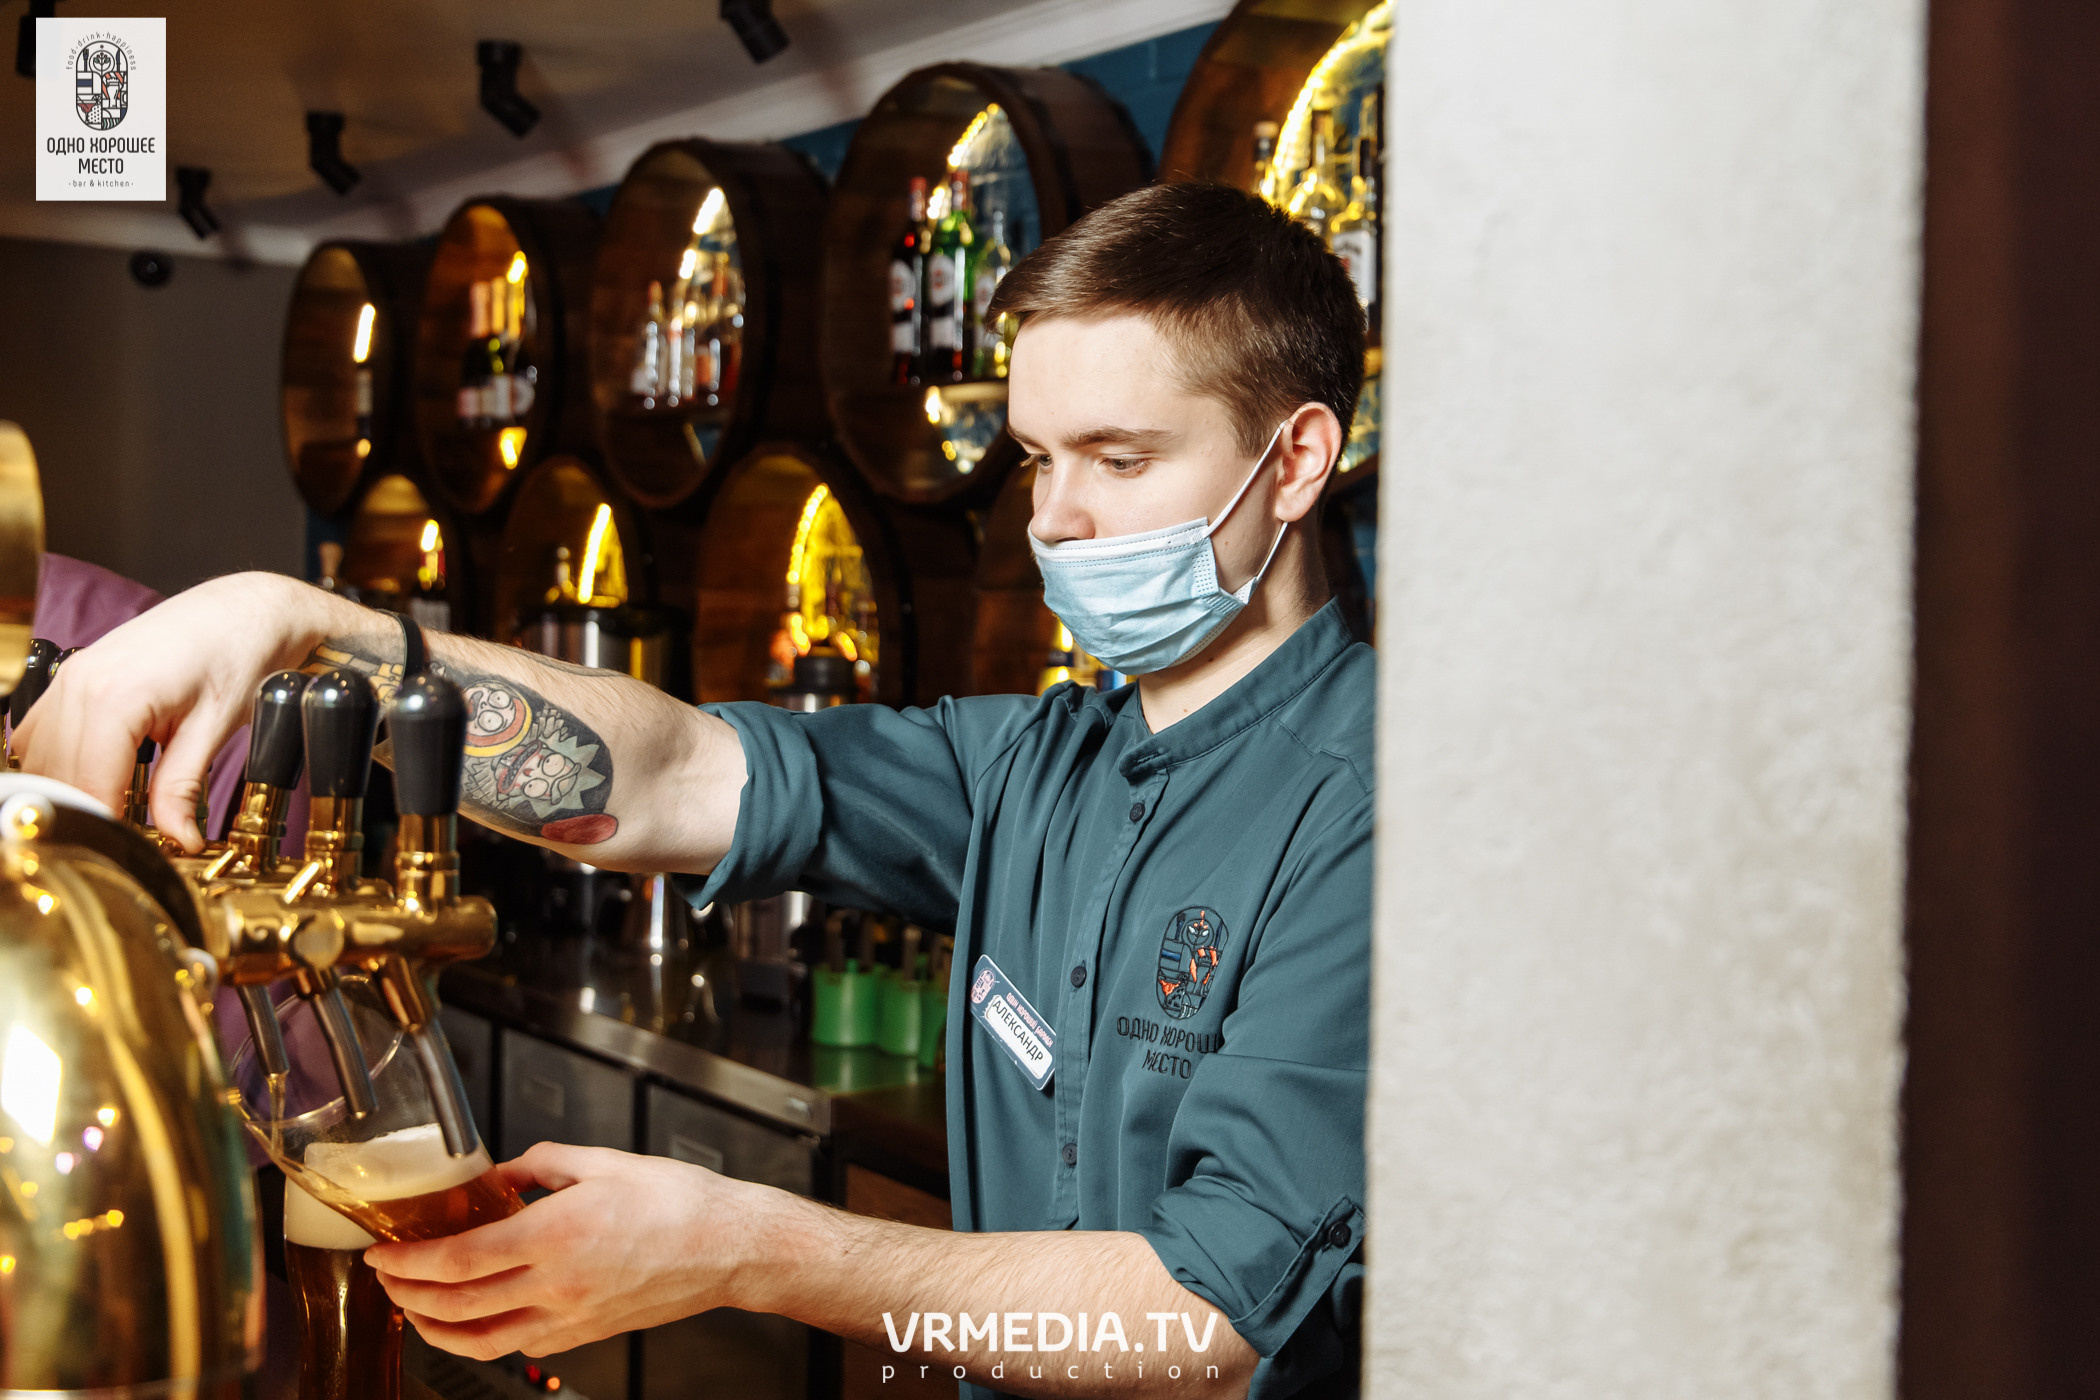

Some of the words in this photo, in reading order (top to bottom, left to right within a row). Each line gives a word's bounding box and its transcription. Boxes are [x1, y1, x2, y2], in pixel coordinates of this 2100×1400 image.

[992, 1000, 1044, 1061] АЛЕКСАНДР
[1117, 1016, 1159, 1043] ОДНО
[1142, 1049, 1192, 1079] МЕСТО
